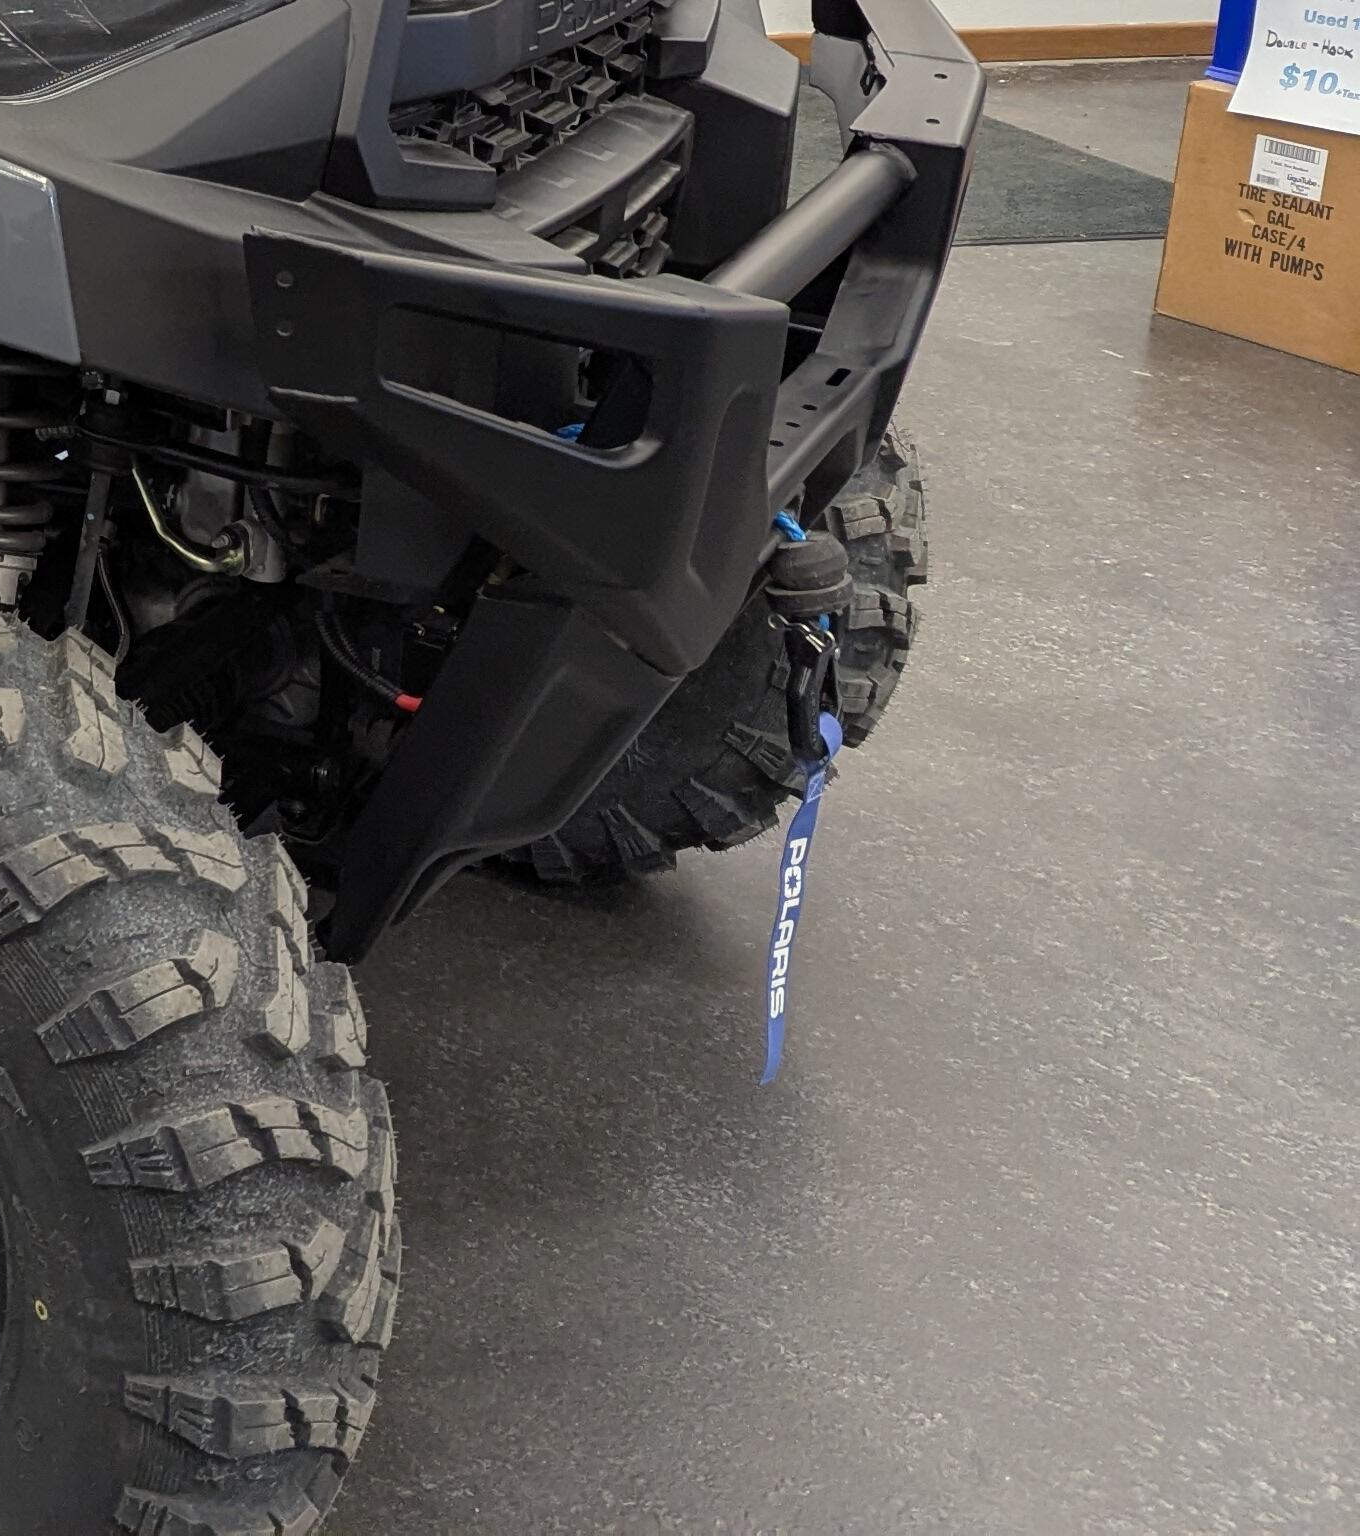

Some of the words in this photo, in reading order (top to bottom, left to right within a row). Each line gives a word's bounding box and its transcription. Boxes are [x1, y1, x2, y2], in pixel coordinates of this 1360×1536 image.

[1304, 9, 1349, 29] Used
[1238, 182, 1268, 204] TIRE
[1271, 192, 1334, 221] SEALANT
[1252, 224, 1306, 252] CASE/4
[1224, 237, 1263, 264] WITH
[1269, 251, 1325, 281] PUMPS
[770, 837, 807, 1019] POLARIS
